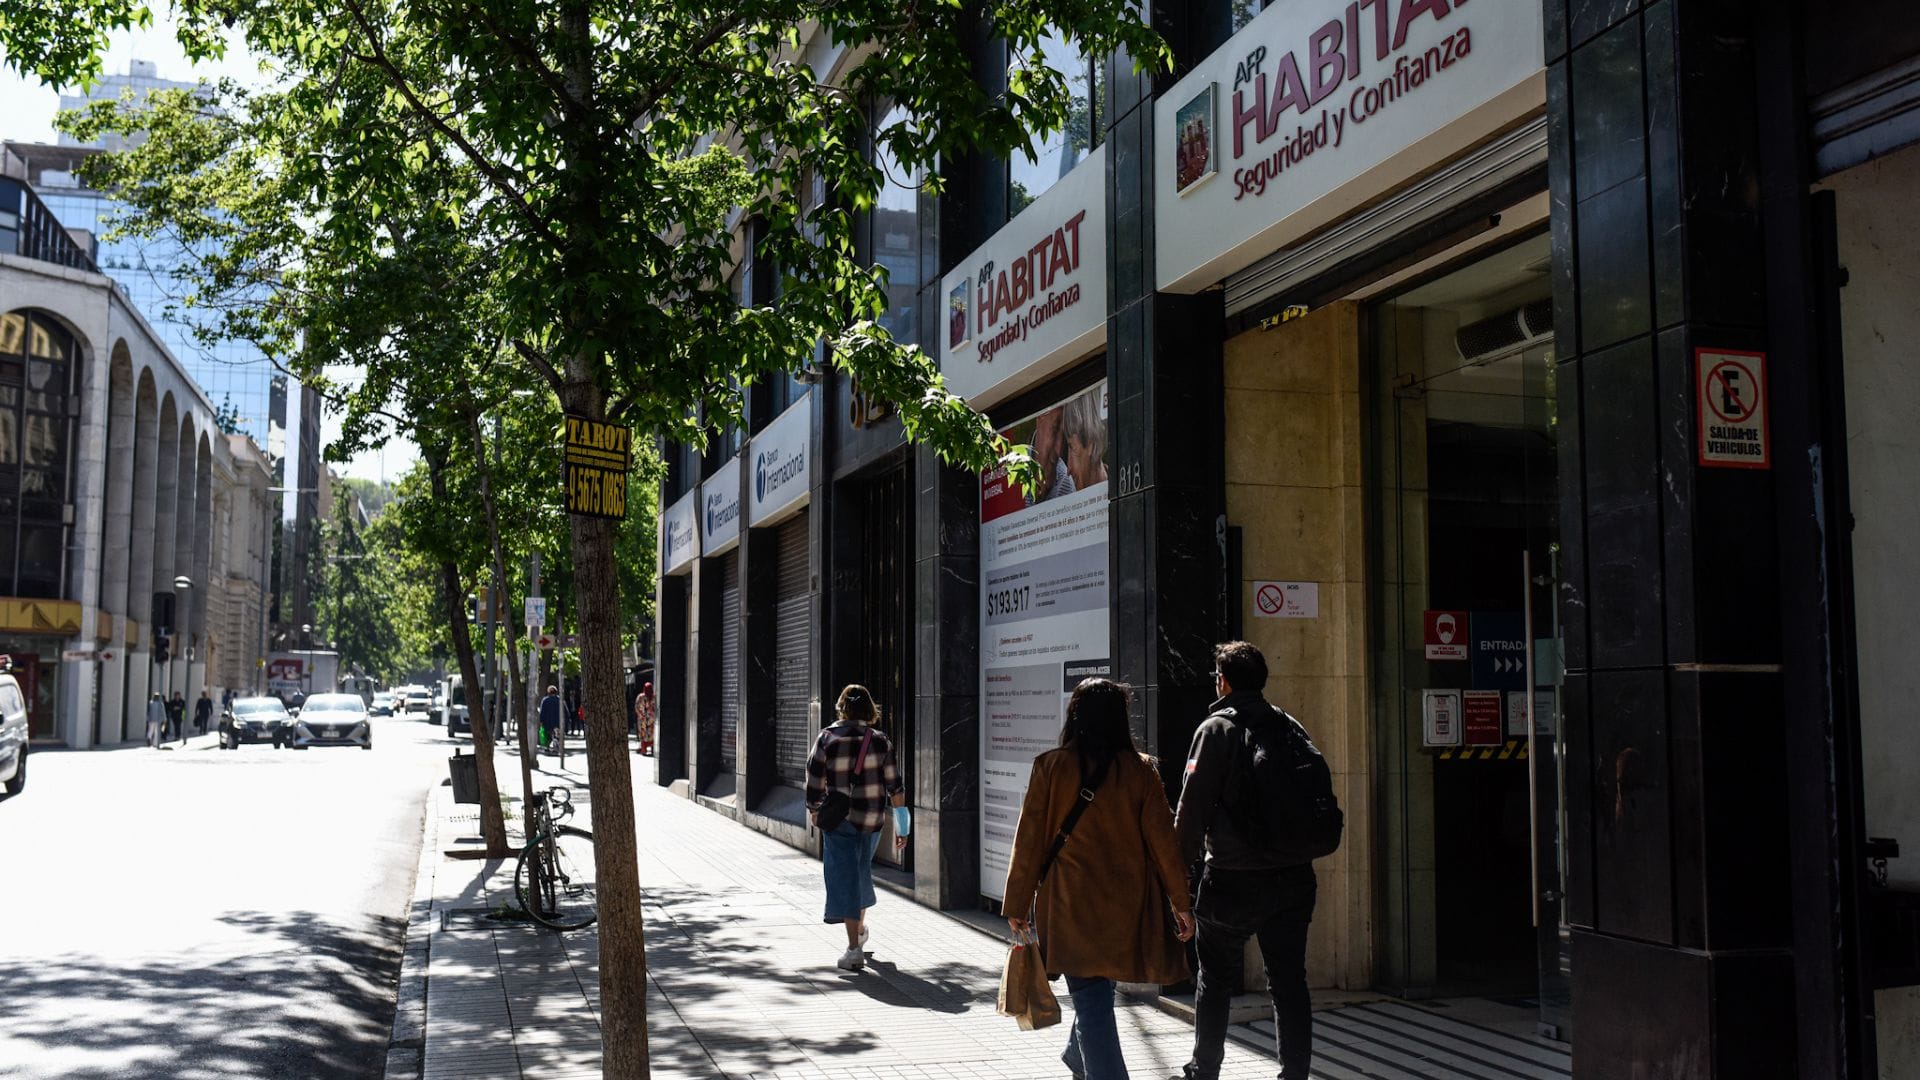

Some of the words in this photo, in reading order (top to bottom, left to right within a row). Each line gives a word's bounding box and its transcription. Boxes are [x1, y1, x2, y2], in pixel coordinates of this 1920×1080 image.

[1232, 0, 1468, 160] HABITA
[1233, 45, 1266, 91] AFP
[1234, 109, 1327, 200] Seguridad
[1332, 107, 1345, 147] y
[1349, 27, 1471, 124] Confianza
[978, 209, 1086, 335] HABITAT
[978, 260, 994, 288] AFP
[978, 315, 1020, 363] Seguridad
[1021, 315, 1028, 341] y
[1029, 283, 1080, 329] Confianza
[568, 419, 627, 452] TAROT
[1707, 441, 1762, 456] VEHICULOS
[767, 448, 778, 466] Banco
[767, 443, 804, 494] Internacional
[569, 465, 577, 511] 9
[577, 466, 600, 514] 5675
[603, 470, 625, 517] 0863
[1119, 462, 1141, 494] 818
[714, 499, 739, 530] Internaciona
[987, 584, 1030, 620] $193.917
